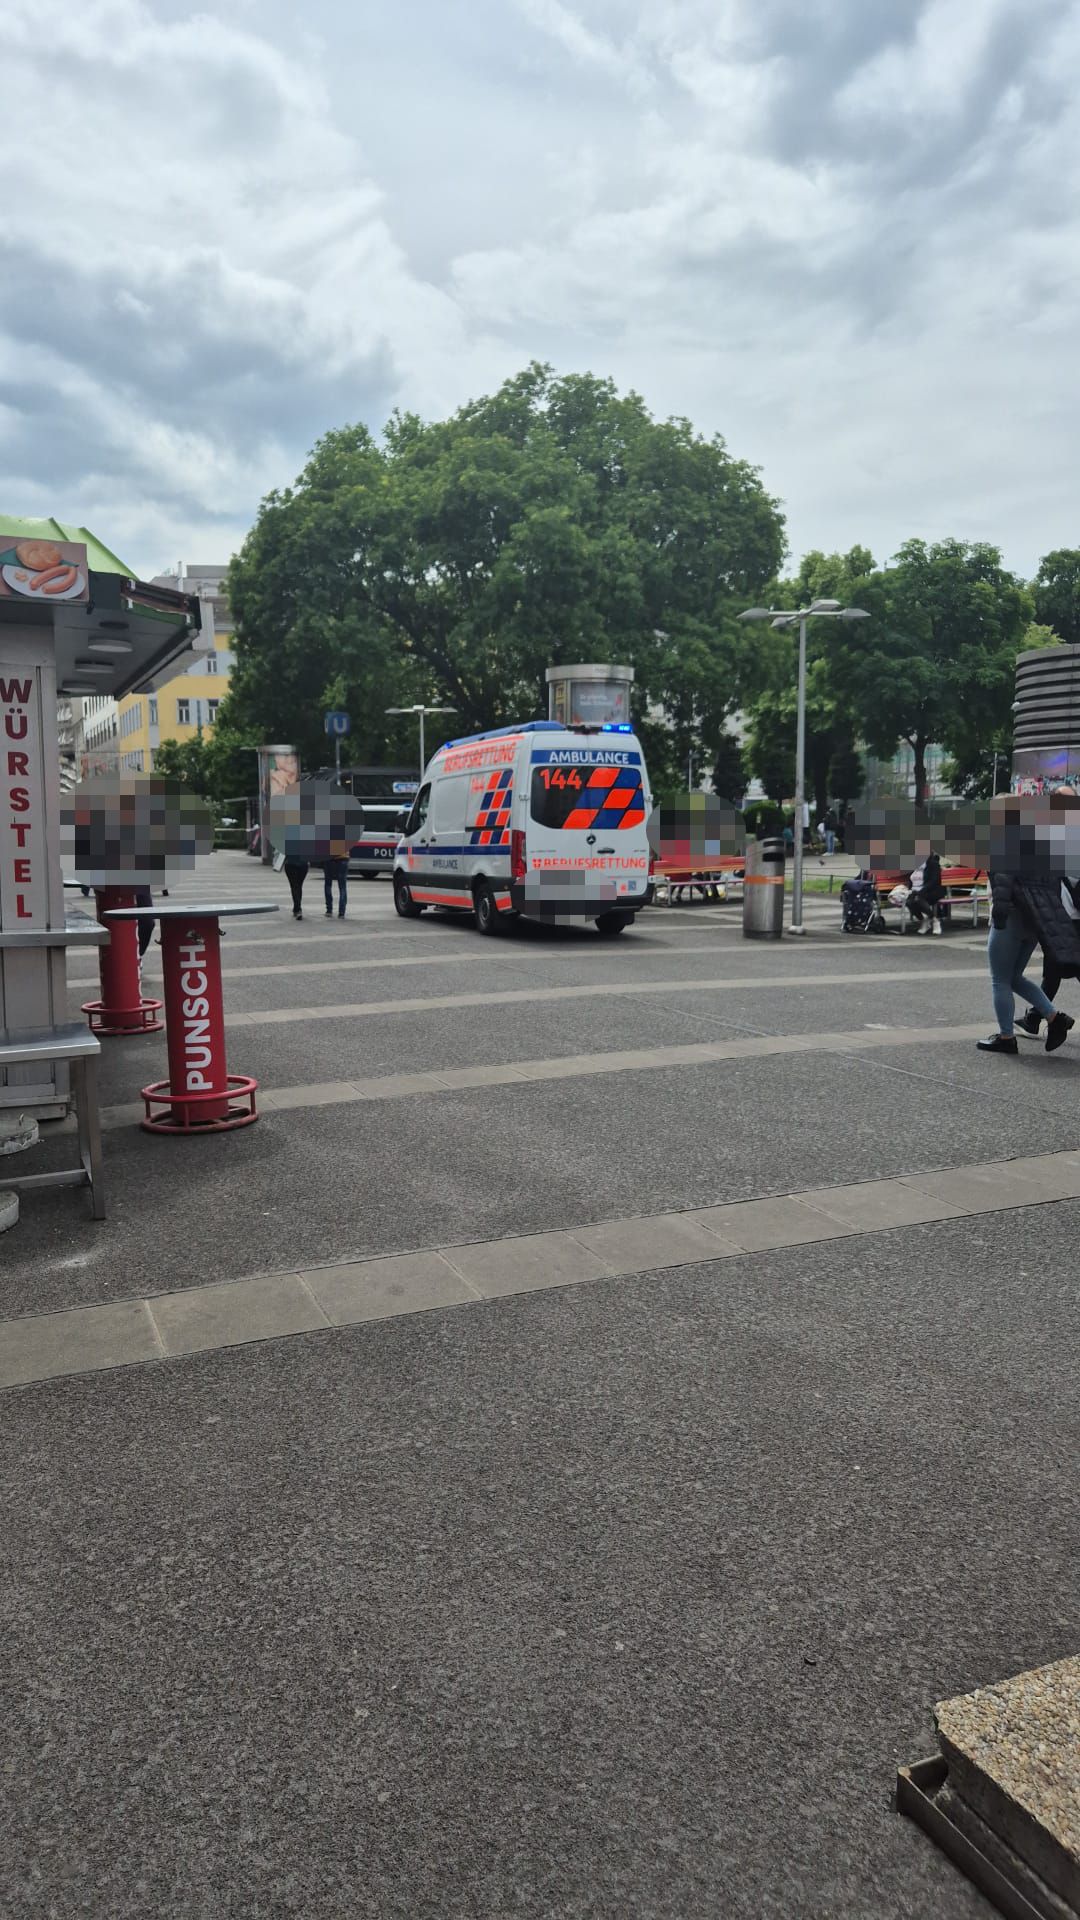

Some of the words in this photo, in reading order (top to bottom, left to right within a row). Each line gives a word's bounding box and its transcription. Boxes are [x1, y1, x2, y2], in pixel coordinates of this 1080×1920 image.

[333, 718, 347, 733] U
[548, 751, 629, 764] AMBULANCE
[539, 768, 582, 790] 144
[0, 678, 33, 918] WÜRSTEL
[432, 859, 458, 870] AMBULANCE
[179, 945, 213, 1091] PUNSCH
